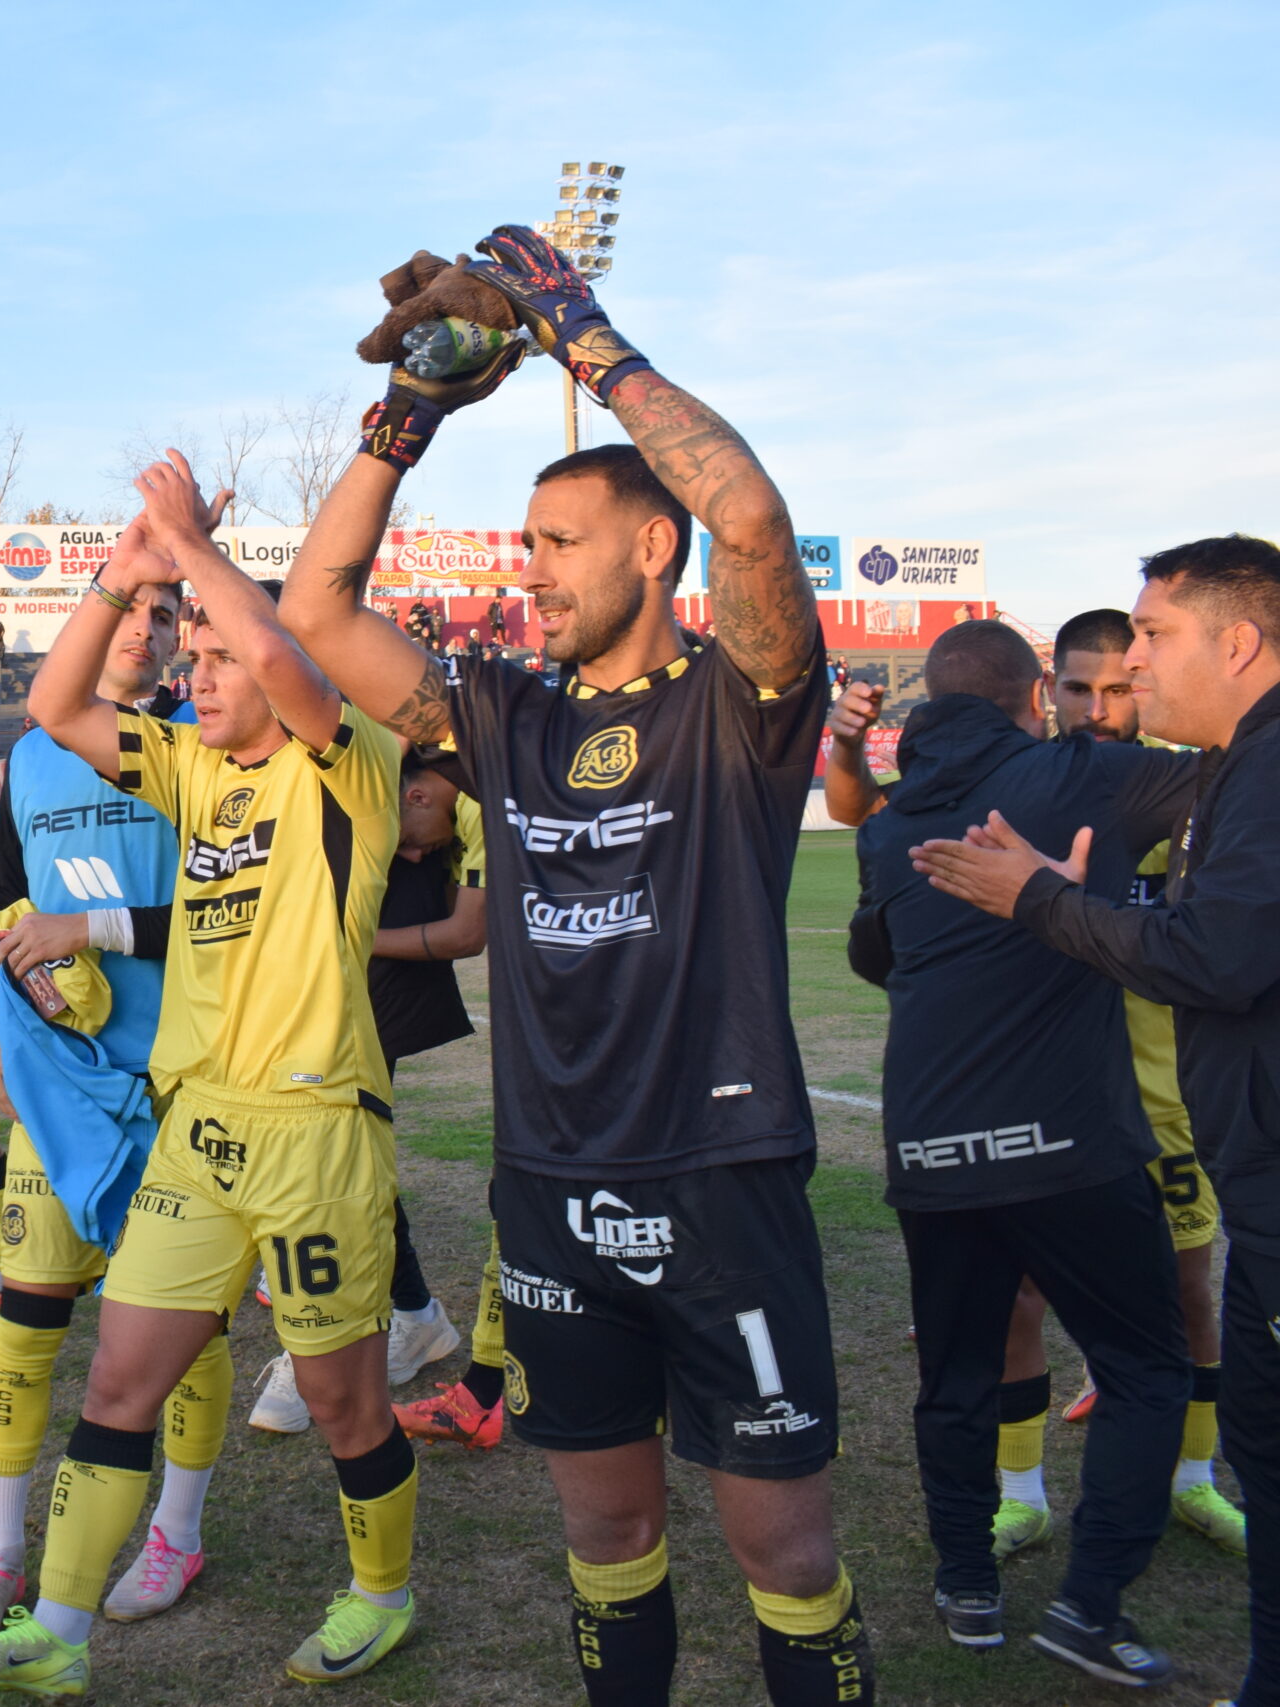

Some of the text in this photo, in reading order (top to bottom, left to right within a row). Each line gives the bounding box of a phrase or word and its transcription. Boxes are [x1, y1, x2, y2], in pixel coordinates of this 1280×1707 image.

[60, 532, 105, 544] AGUA
[434, 535, 454, 550] La
[60, 547, 80, 559] LA
[402, 547, 488, 571] Sureña
[901, 546, 980, 566] SANITARIOS
[60, 562, 102, 574] ESPE
[377, 574, 411, 584] TAPAS
[901, 567, 958, 585] URIARTE
[14, 602, 79, 614] MORENO
[31, 800, 157, 838] RETIEL
[897, 1120, 1075, 1171] RETIEL
[1160, 1152, 1200, 1206] 5
[566, 1196, 675, 1248] LIDER
[271, 1231, 342, 1298] 16
[735, 1307, 784, 1397] 1
[734, 1413, 820, 1437] RETIEL
